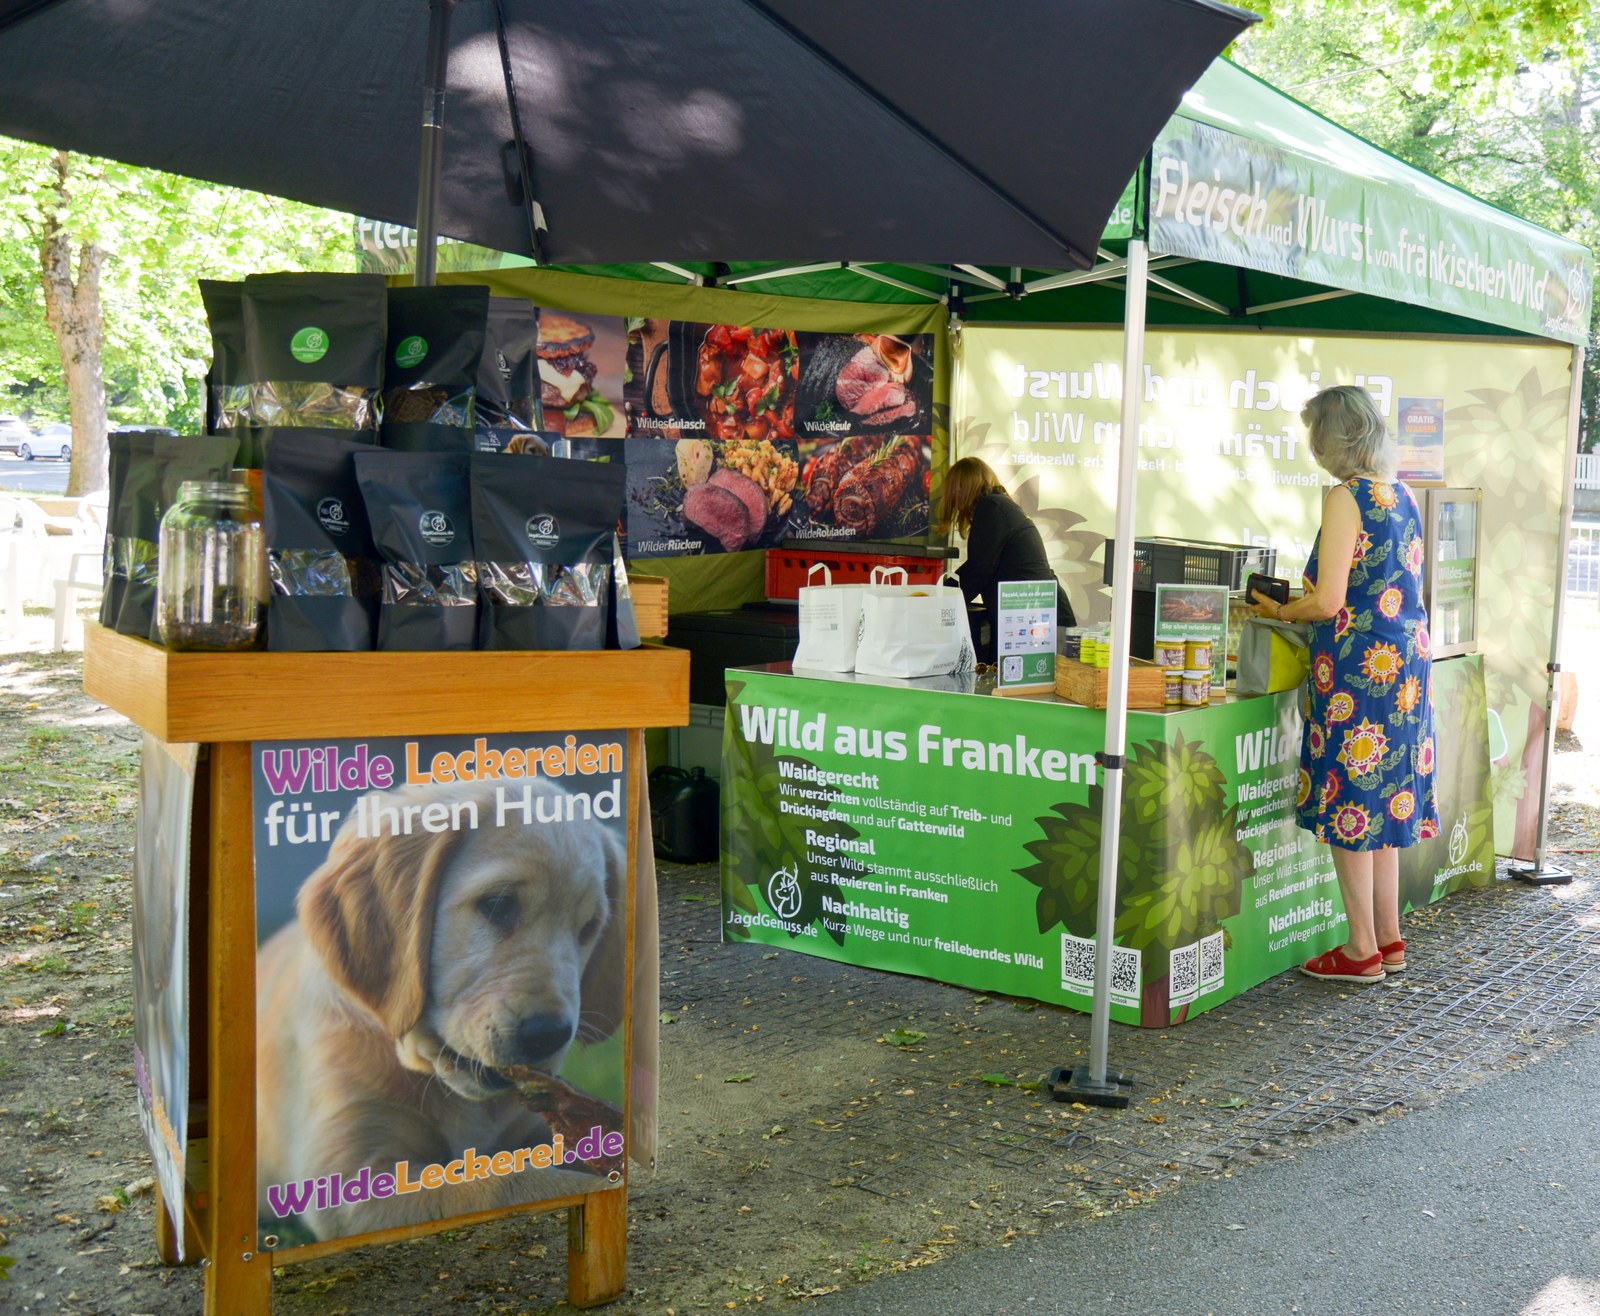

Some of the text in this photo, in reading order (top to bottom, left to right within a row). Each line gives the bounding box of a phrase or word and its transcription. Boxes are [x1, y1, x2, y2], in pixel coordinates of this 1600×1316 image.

[1156, 156, 1550, 312] Fleisch und Wurst von fränkischen Wild
[637, 417, 705, 430] WildesGulasch
[803, 420, 851, 432] WildeKeule
[1407, 415, 1435, 424] GRATIS
[638, 539, 701, 552] WilderRücken
[795, 527, 856, 539] WildeRouladen
[740, 704, 1098, 786] Wild aus Franken
[1235, 726, 1292, 774] Wild
[261, 734, 623, 796] Wilde Leckereien
[778, 760, 879, 790] Waidgerecht
[1237, 768, 1300, 803] Waidgerech
[264, 778, 621, 847] für Ihren Hund
[779, 783, 1012, 827] Wir verzichten vollständig auf Treib- und
[780, 800, 964, 839] Drückjagden und auf Gatterwild
[1237, 808, 1250, 822] Wir
[1251, 798, 1288, 818] verzichten
[806, 829, 876, 856] Regional
[1237, 818, 1282, 842] Drückjagden
[1253, 836, 1303, 869] Regional
[807, 851, 998, 893] Unser Wild stammt ausschließlich
[810, 871, 948, 903] aus Revieren in Franken
[1253, 872, 1275, 889] Unser
[1276, 863, 1292, 880] Wild
[1294, 854, 1325, 873] stammt
[1255, 895, 1267, 908] aus
[1269, 882, 1305, 902] Revieren
[1307, 874, 1314, 888] in
[726, 910, 818, 938] JagdGenuss.de
[822, 896, 909, 929] Nachhaltig
[1269, 897, 1333, 934] Nachhaltig
[823, 917, 1044, 970] Kurze Wege und nur freilebendes Wild
[1268, 936, 1289, 952] Kurze
[1289, 928, 1310, 942] Wege
[1311, 920, 1325, 935] und
[267, 1125, 624, 1218] WildeLeckerei.de
